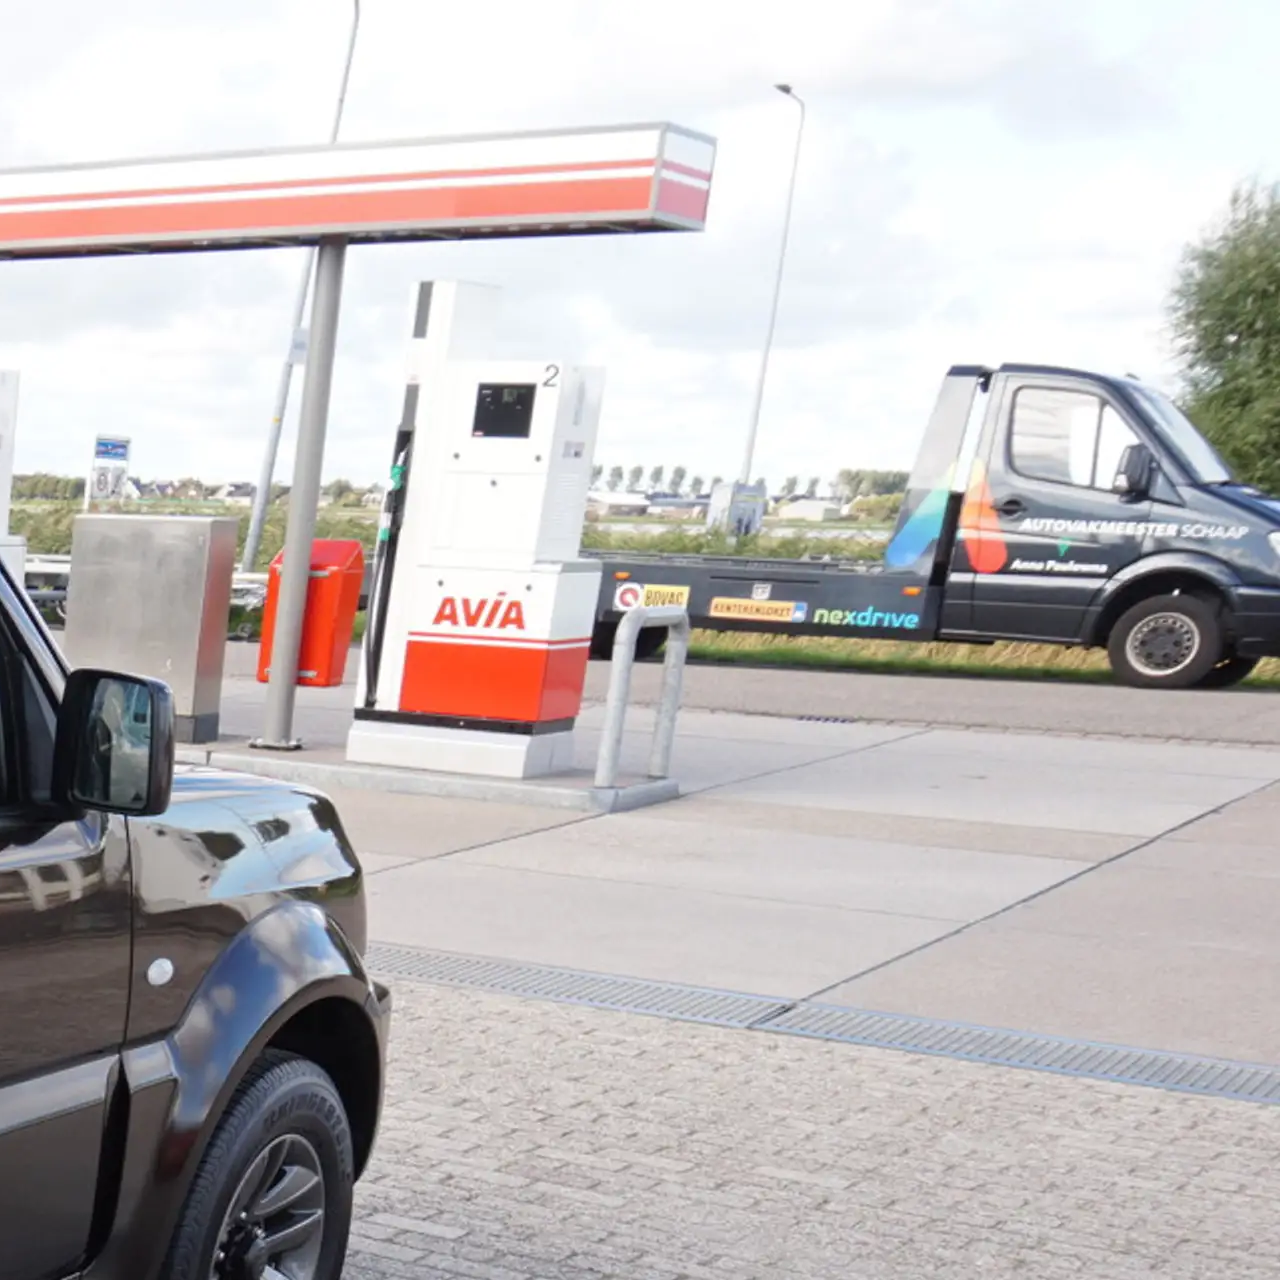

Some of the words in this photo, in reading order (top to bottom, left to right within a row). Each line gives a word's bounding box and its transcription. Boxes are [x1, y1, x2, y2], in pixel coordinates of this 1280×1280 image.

[543, 363, 560, 388] 2
[1019, 518, 1177, 538] AUTOVAKMEESTER
[1180, 523, 1249, 540] SCHAAP
[813, 606, 919, 629] nexdrive
